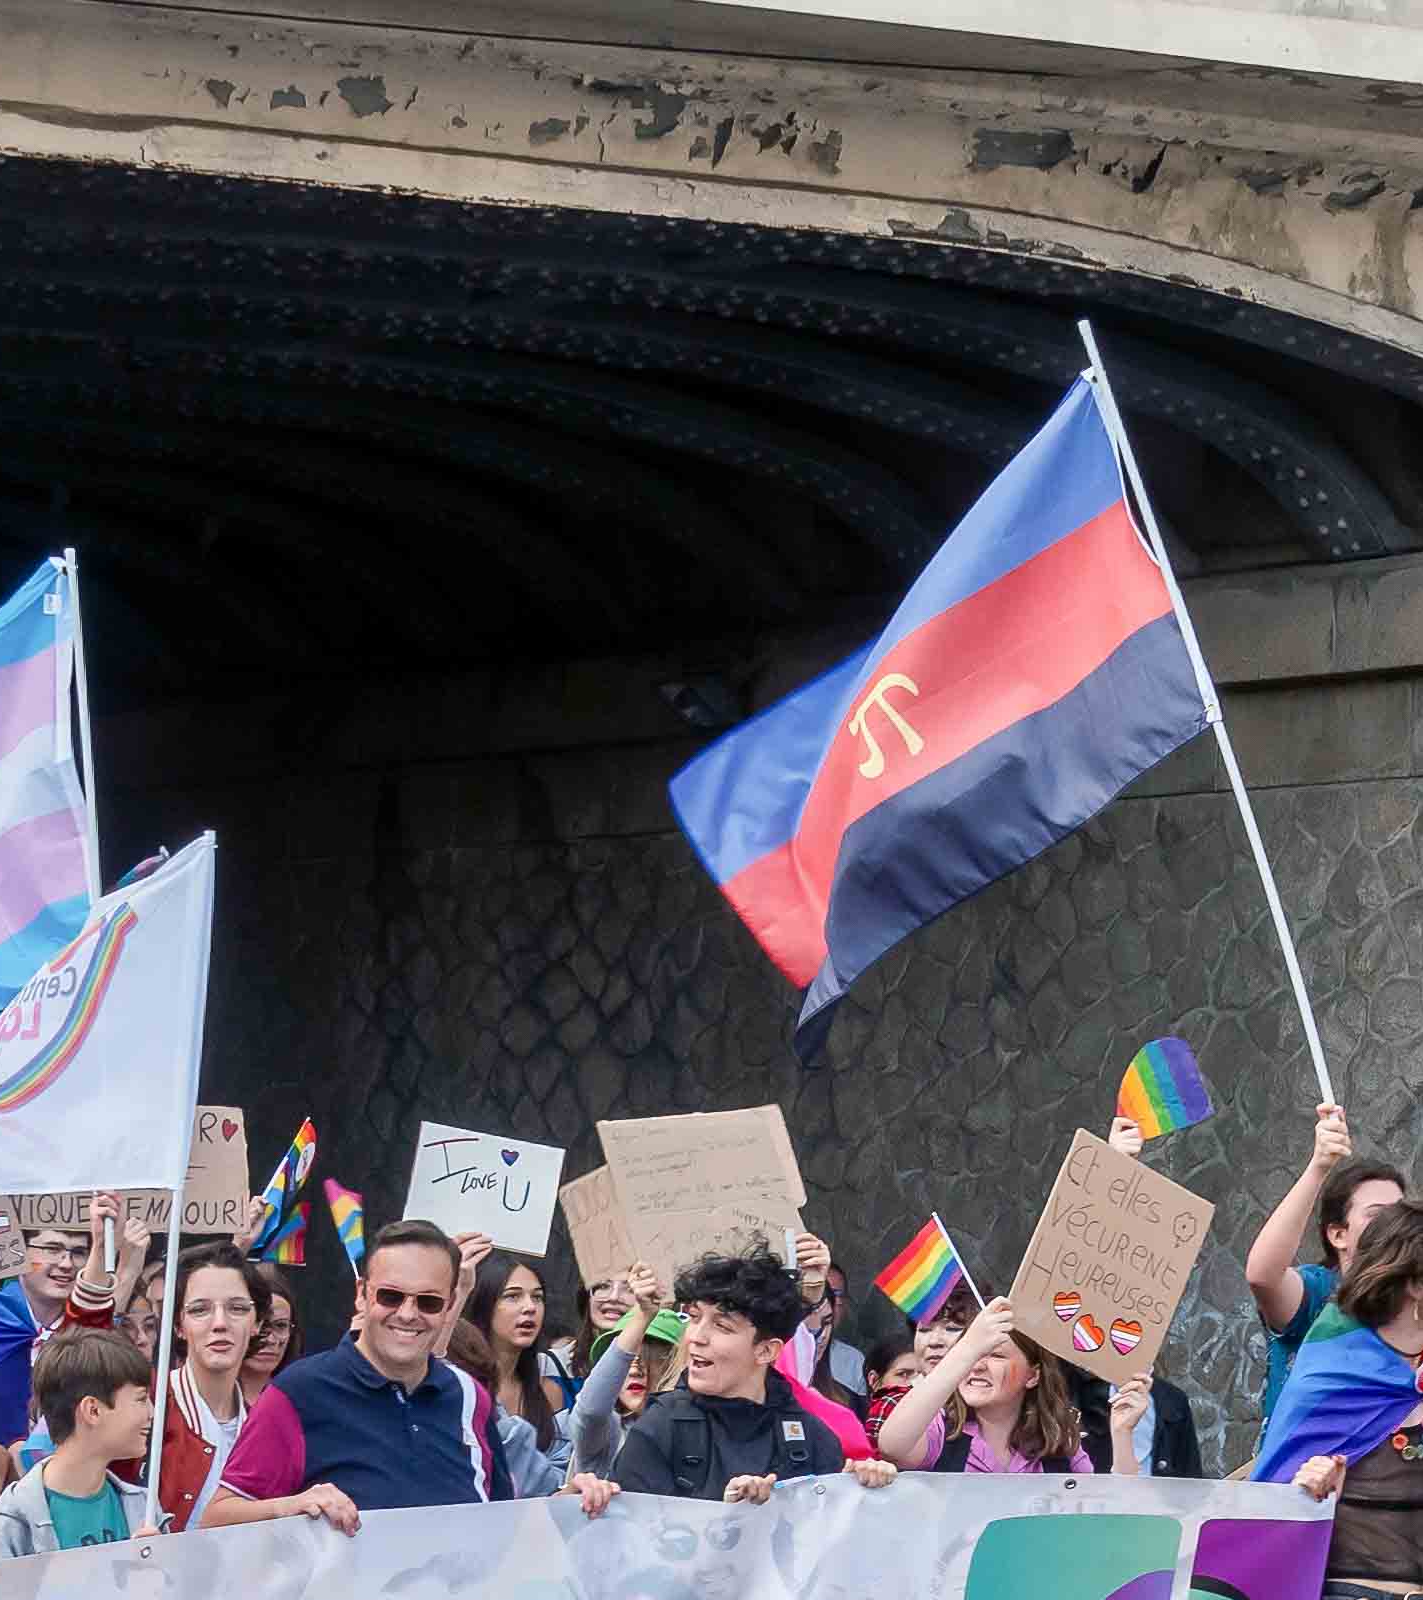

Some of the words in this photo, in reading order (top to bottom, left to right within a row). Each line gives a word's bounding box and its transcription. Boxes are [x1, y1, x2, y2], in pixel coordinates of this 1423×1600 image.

[423, 1137, 480, 1184] I
[461, 1172, 498, 1194] LOVE
[502, 1175, 531, 1212] U
[1108, 1172, 1161, 1224] elles
